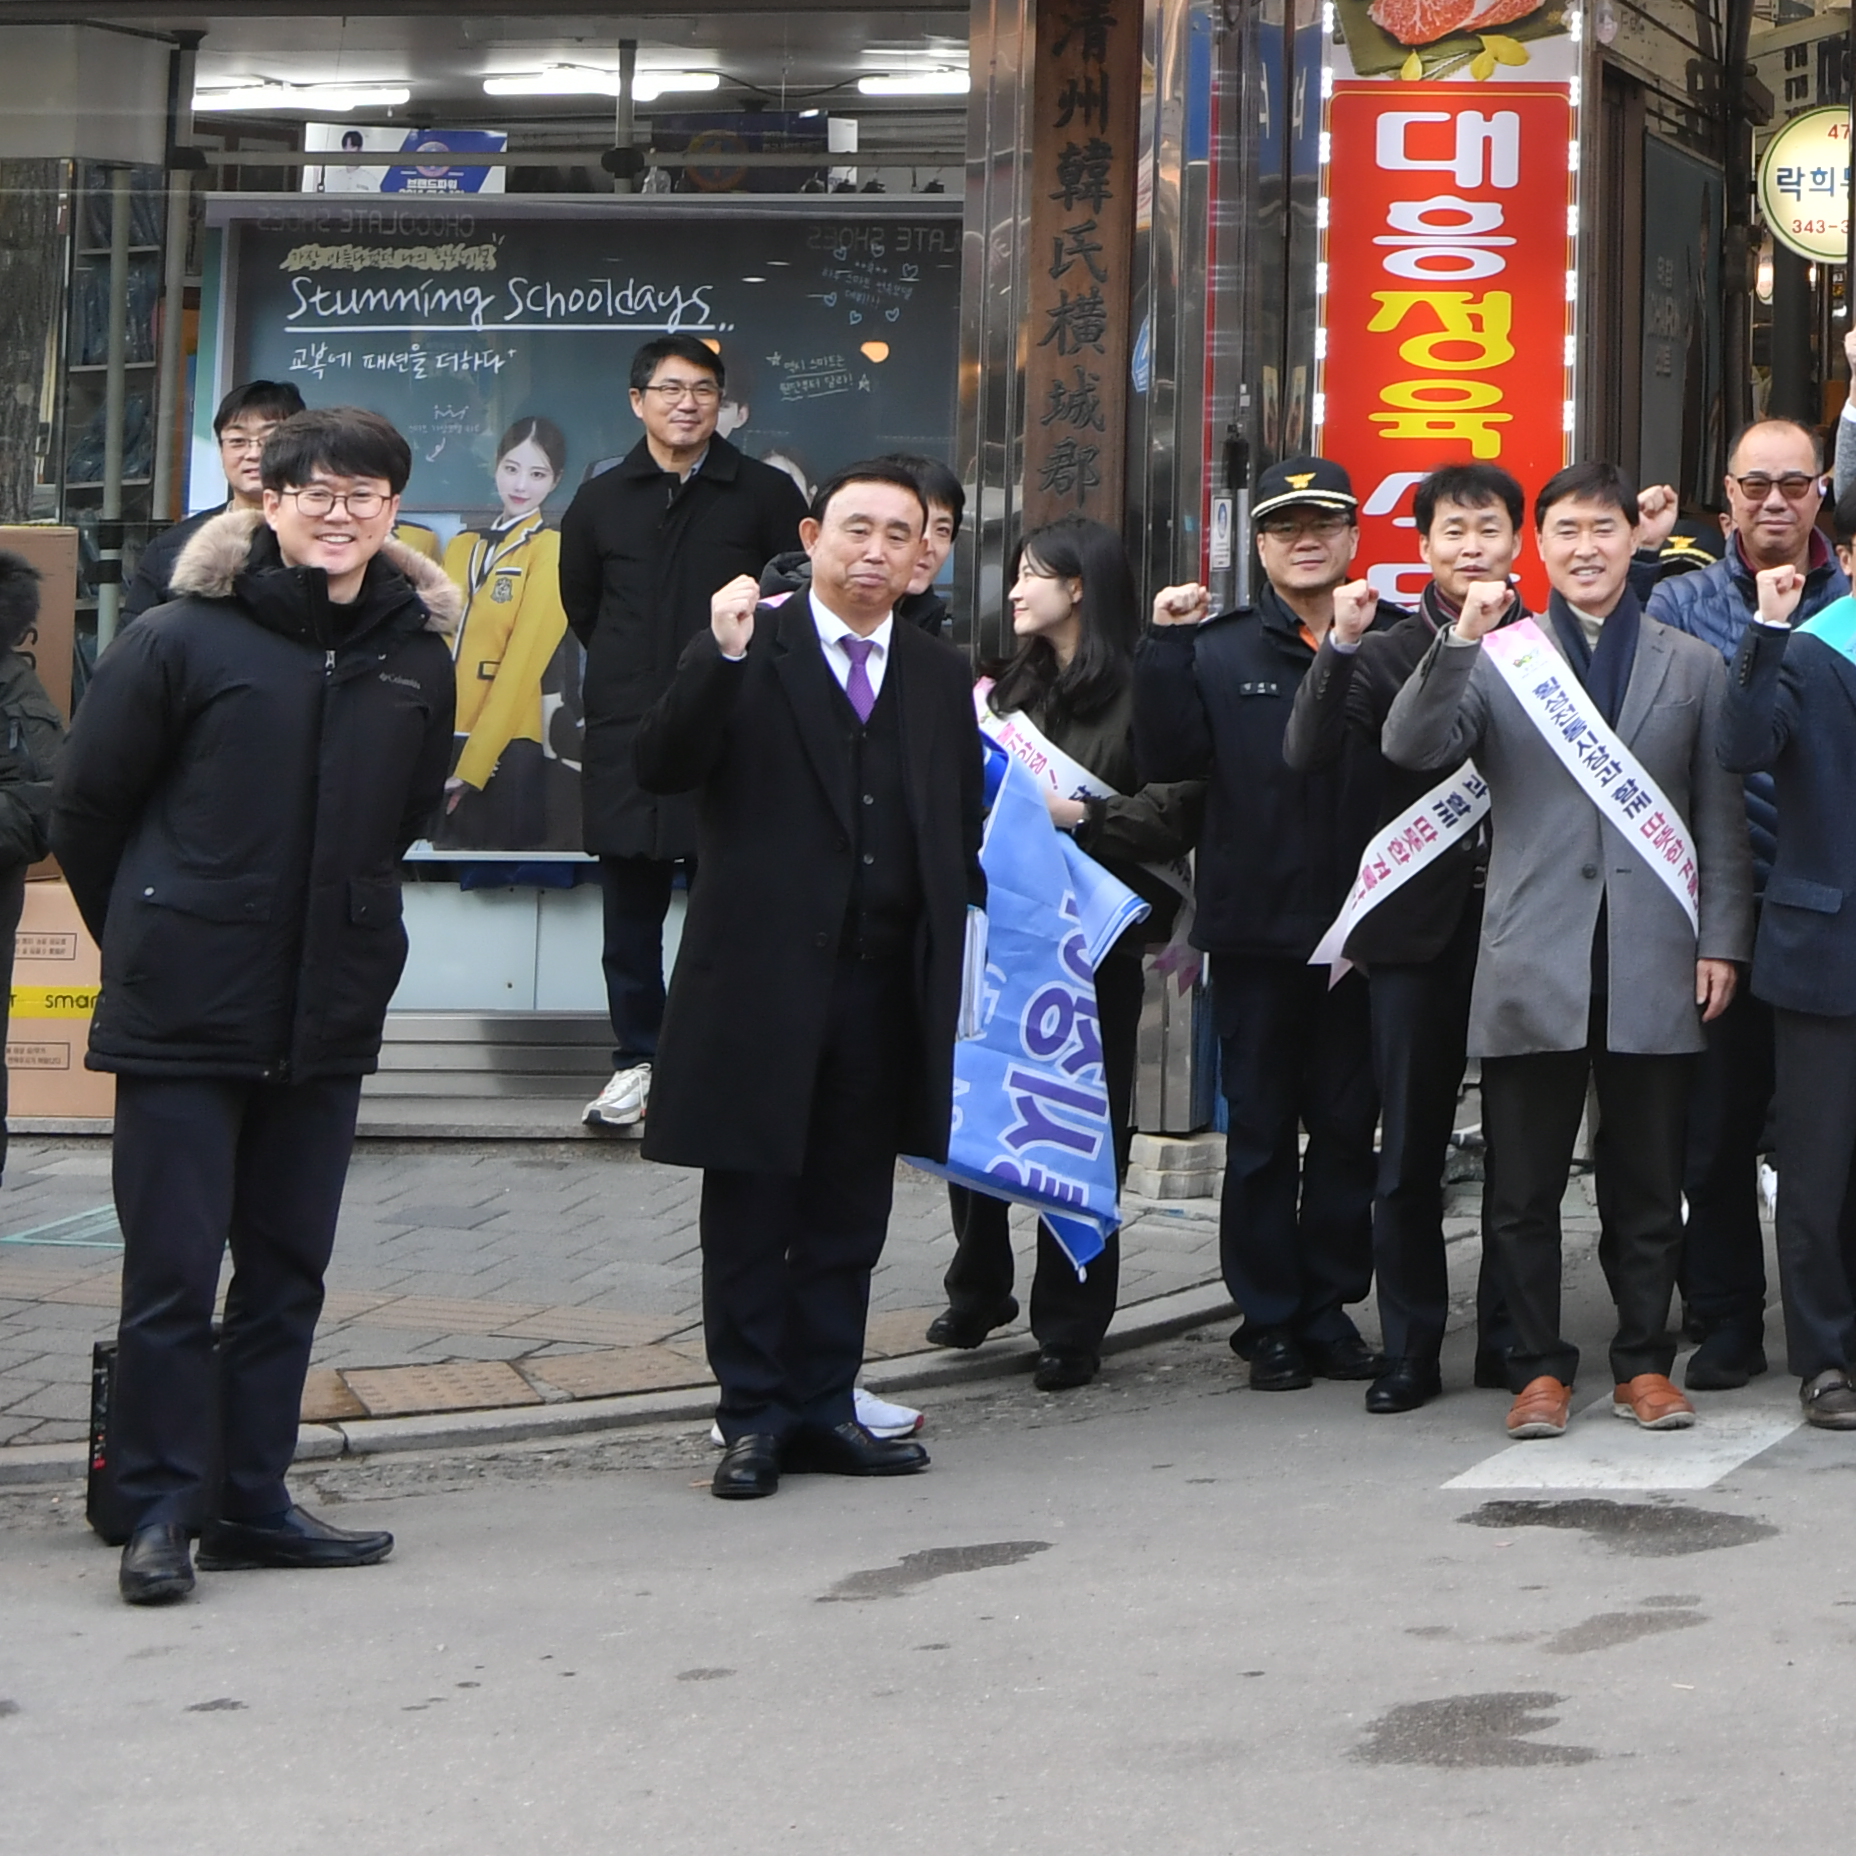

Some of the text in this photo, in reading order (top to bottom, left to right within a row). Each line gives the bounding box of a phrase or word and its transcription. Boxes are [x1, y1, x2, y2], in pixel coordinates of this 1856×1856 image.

[286, 276, 716, 333] Stunning Schooldays
[289, 343, 429, 381] 교복에 패션을
[1365, 110, 1521, 604] 대흥정육
[1610, 778, 1653, 821] 함께
